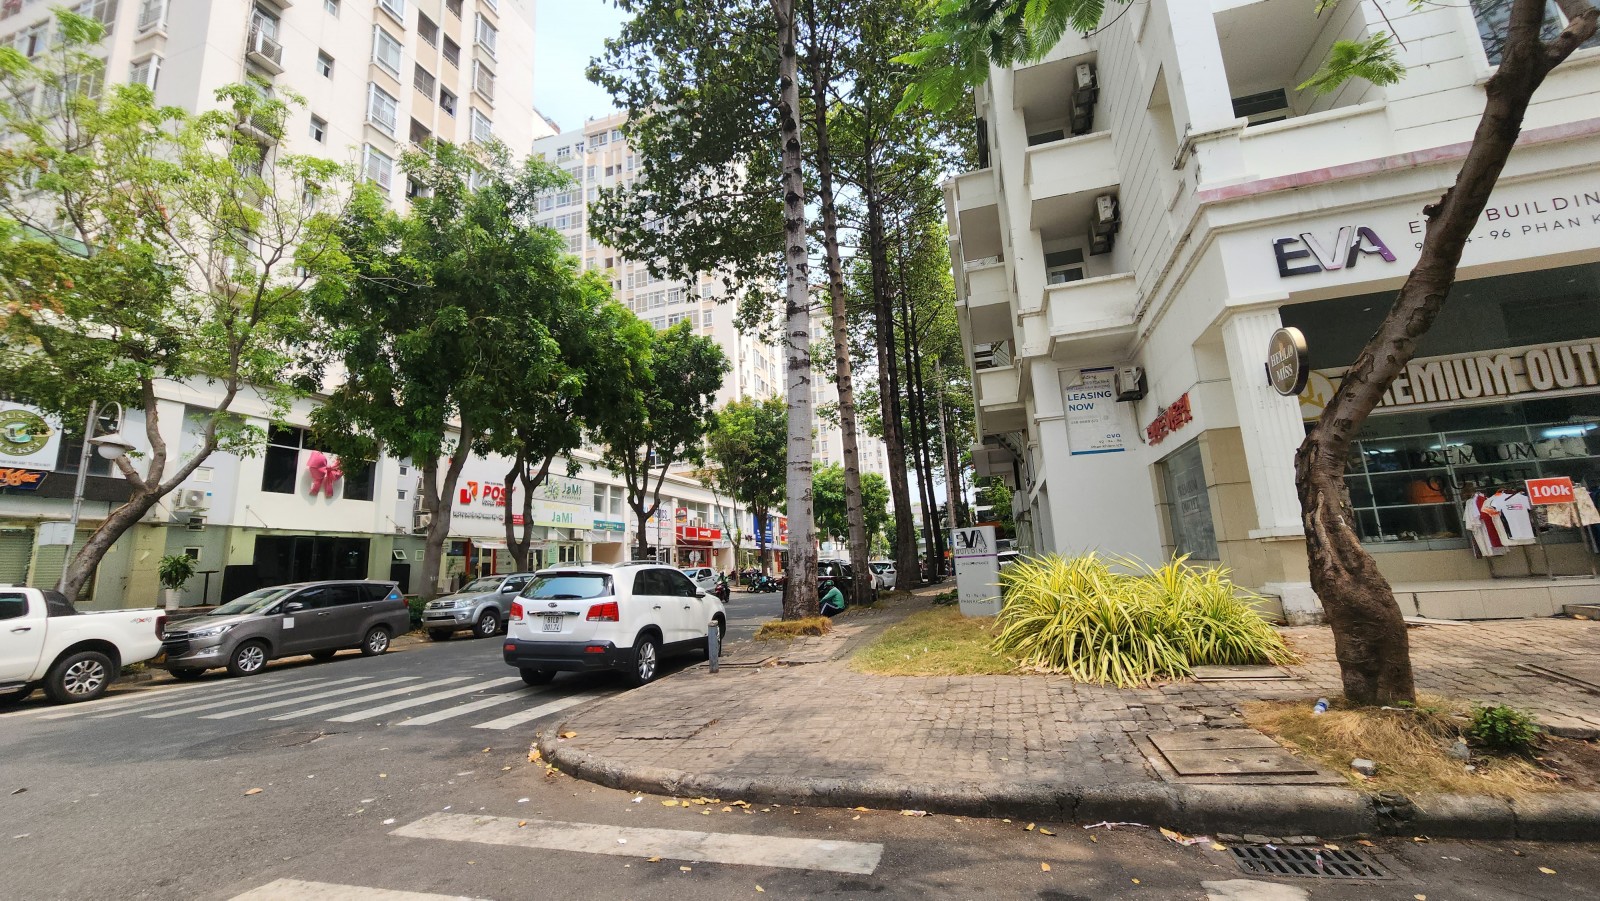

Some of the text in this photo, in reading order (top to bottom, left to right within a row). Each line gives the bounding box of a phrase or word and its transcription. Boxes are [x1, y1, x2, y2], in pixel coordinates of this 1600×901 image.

[1521, 217, 1581, 236] PHAN
[1272, 225, 1397, 277] EVA
[1378, 354, 1519, 406] EMIUM
[1067, 390, 1112, 402] LEASING
[1069, 402, 1094, 412] NOW
[561, 482, 582, 495] JaMi
[1531, 484, 1571, 498] 100k
[551, 511, 573, 524] JaMi
[954, 529, 987, 549] EVA
